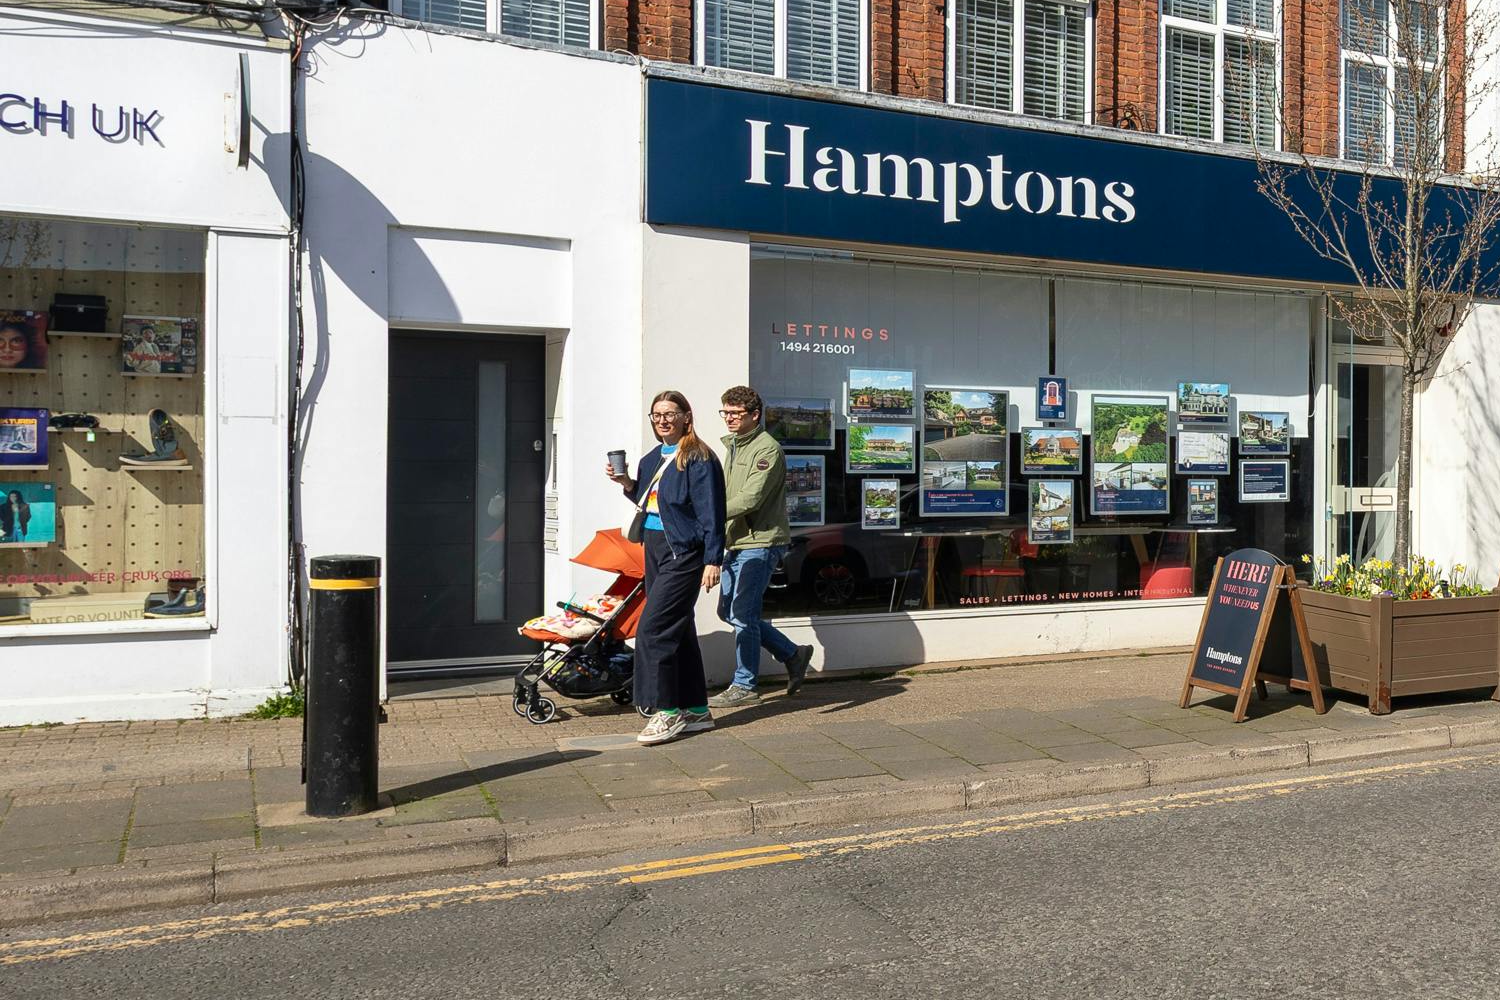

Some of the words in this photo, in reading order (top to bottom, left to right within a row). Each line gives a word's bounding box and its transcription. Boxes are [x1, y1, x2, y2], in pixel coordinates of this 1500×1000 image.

[92, 103, 160, 143] UK
[745, 119, 1136, 224] Hamptons
[772, 322, 889, 341] LETTINGS
[777, 341, 811, 353] 1494
[812, 343, 855, 355] 216001
[122, 569, 192, 583] CRUK.ORG
[1226, 560, 1271, 584] HERE
[959, 596, 990, 605] SALES
[1001, 594, 1048, 603] LETTINGS
[1058, 592, 1079, 600] NEW
[1082, 590, 1114, 599] HOMES
[1124, 587, 1194, 597] INTERONAL
[1223, 583, 1259, 597] WHENEVER
[1219, 595, 1233, 606] YOU
[1233, 597, 1250, 608] NEED
[1250, 601, 1260, 610] US
[1206, 646, 1243, 665] Hamptons
